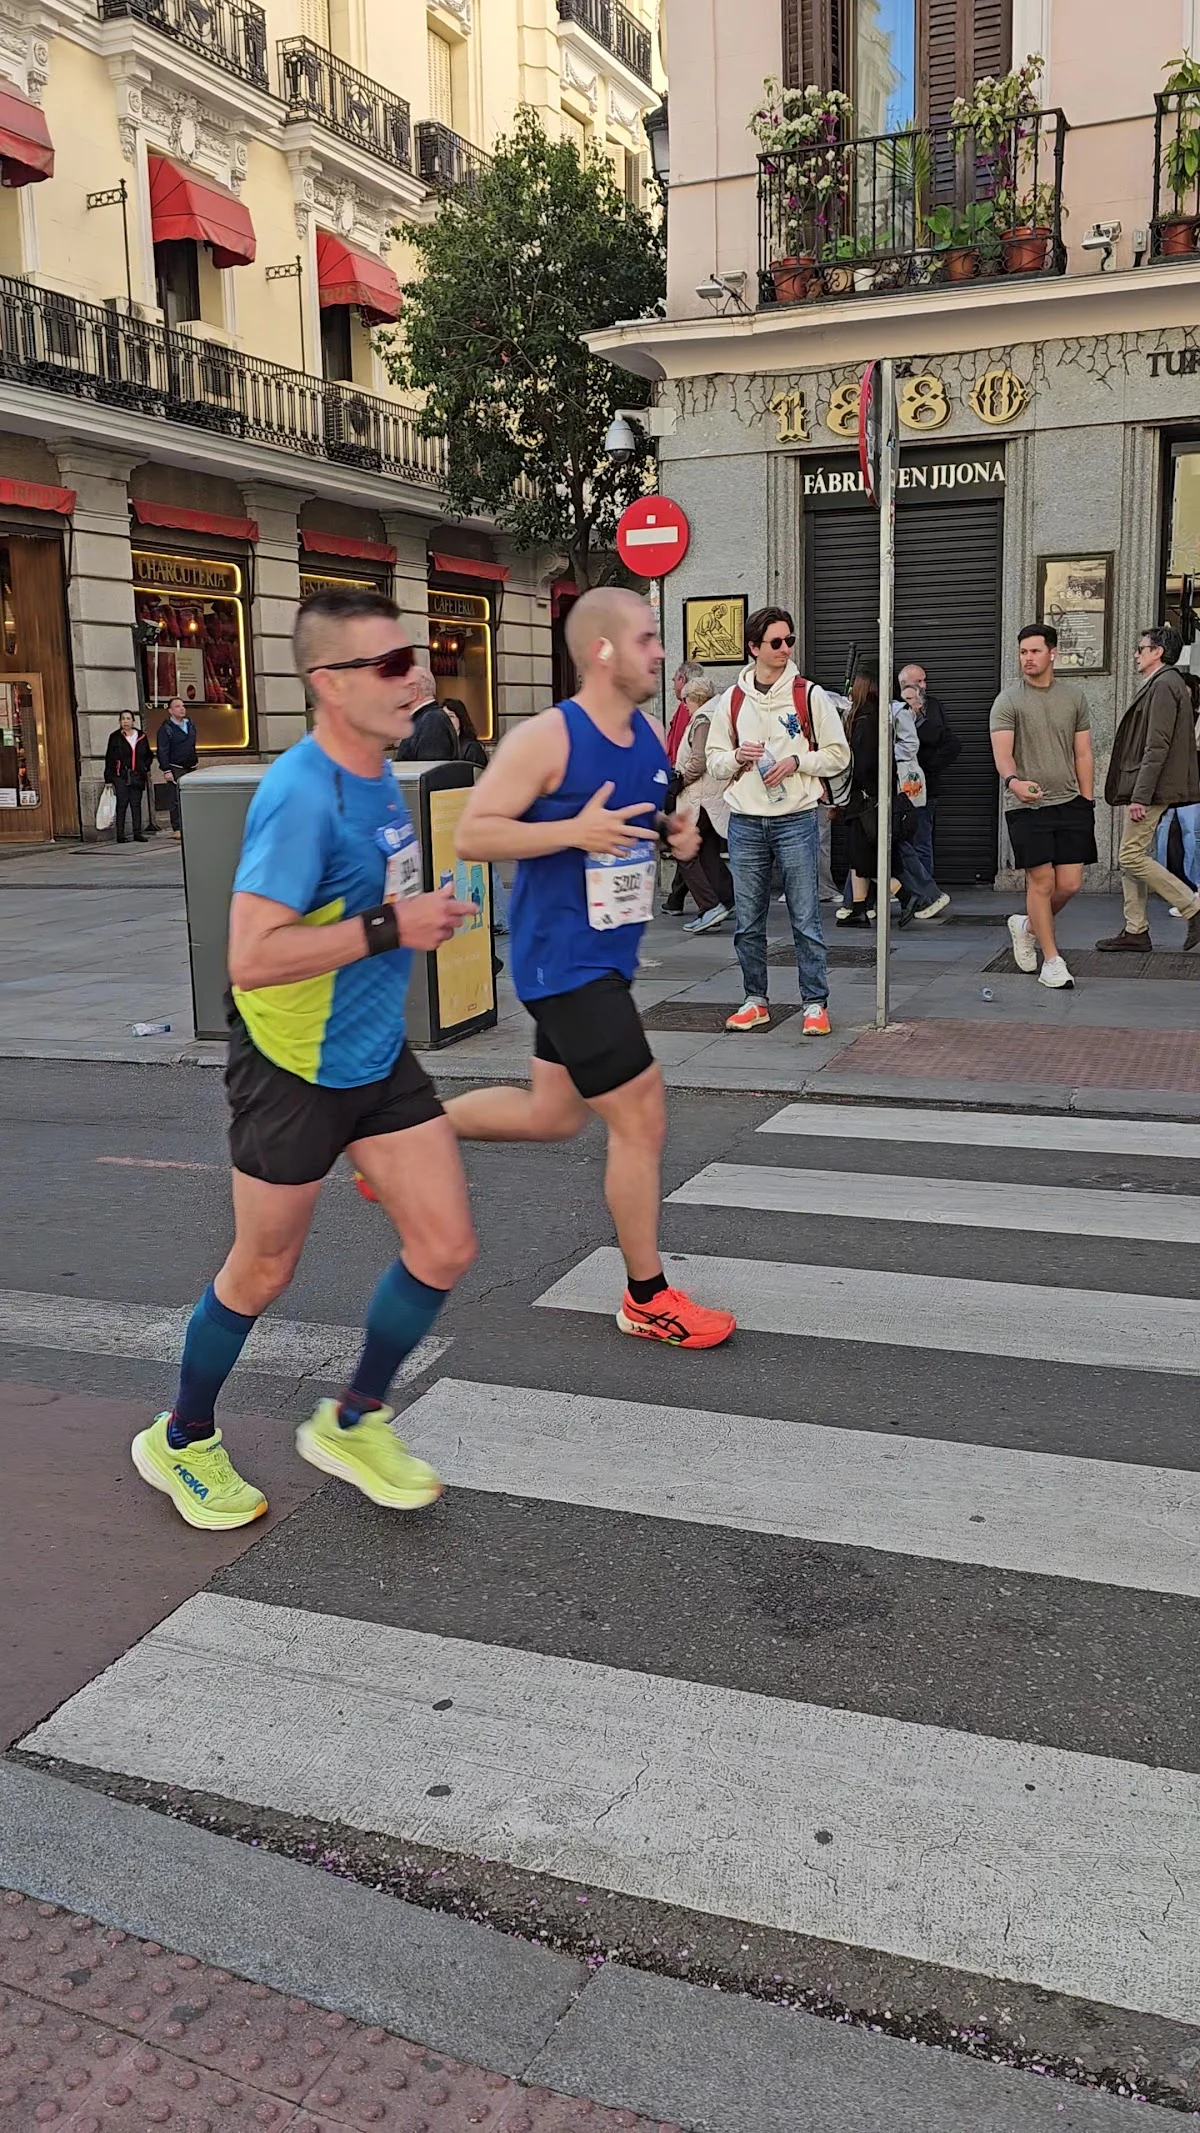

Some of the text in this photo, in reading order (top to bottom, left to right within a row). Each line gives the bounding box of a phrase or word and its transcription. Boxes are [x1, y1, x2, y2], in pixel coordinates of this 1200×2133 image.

[769, 369, 1031, 443] 1880
[803, 460, 1006, 495] FÁBRI EN JIJONA
[172, 1463, 209, 1500] HOKA
